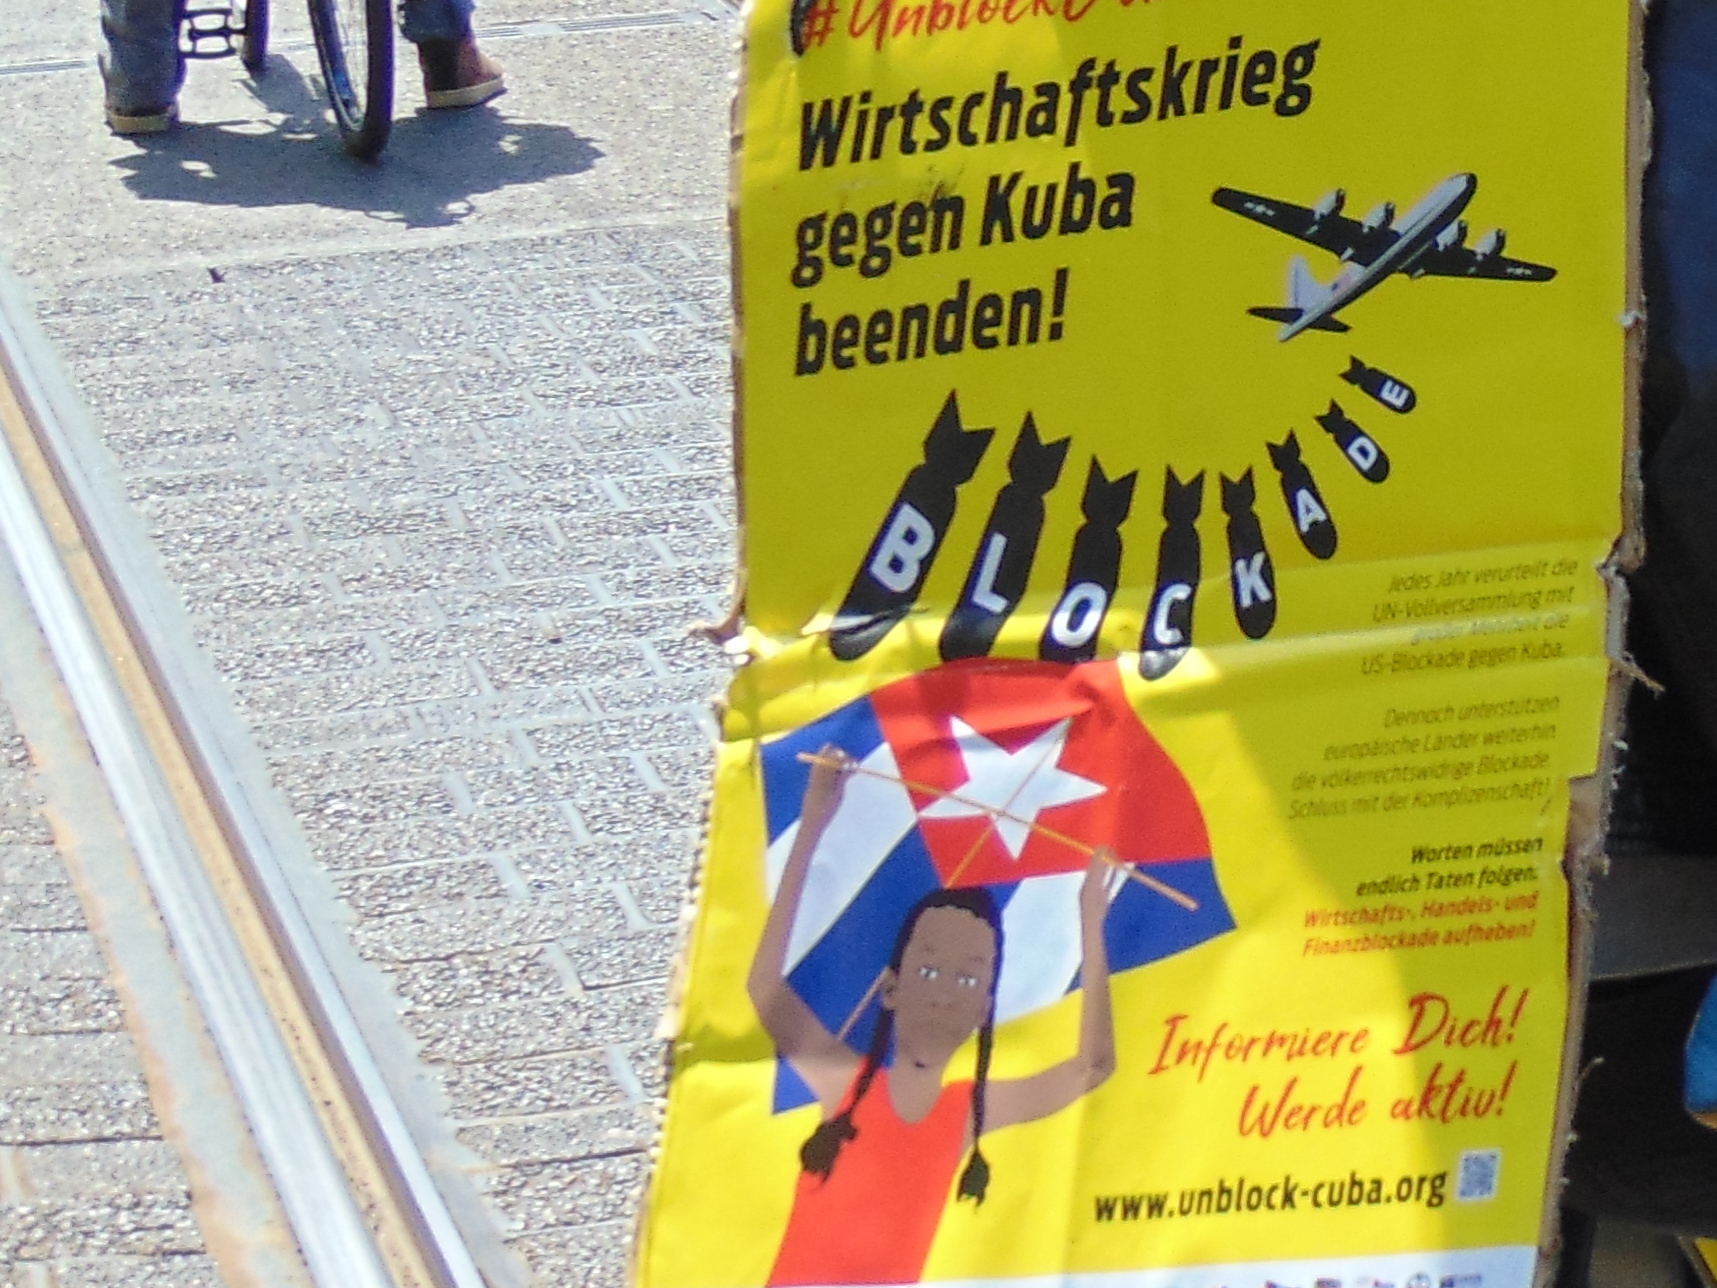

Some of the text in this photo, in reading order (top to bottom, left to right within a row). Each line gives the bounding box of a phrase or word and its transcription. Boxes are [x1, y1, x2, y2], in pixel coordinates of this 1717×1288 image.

[800, 35, 1321, 171] Wirtschaftskrieg
[791, 161, 1136, 288] gegen Kuba
[795, 267, 1070, 376] beenden!
[1388, 559, 1578, 593] Jedes Jahr verurteilt die
[1372, 585, 1576, 623] UN-Vollversammlung mit
[1361, 649, 1465, 676] US-Blockade
[1467, 646, 1518, 670] gegen
[1384, 696, 1560, 728] Dennoch unterstützen
[1291, 772, 1317, 791] die
[1288, 798, 1347, 820] Schluss
[1349, 796, 1379, 813] mit
[1382, 792, 1410, 811] der
[1410, 836, 1543, 864] Worten müssen
[1355, 873, 1421, 897] endlich
[1425, 871, 1474, 891] Taten
[1504, 890, 1539, 911] und
[1303, 918, 1536, 957] Finanzblockade aufheben!
[1147, 984, 1530, 1083] Informiere Dich!
[1238, 1058, 1518, 1139] Werde aktiv!
[1095, 1168, 1449, 1222] www.unblock-cuba.org
